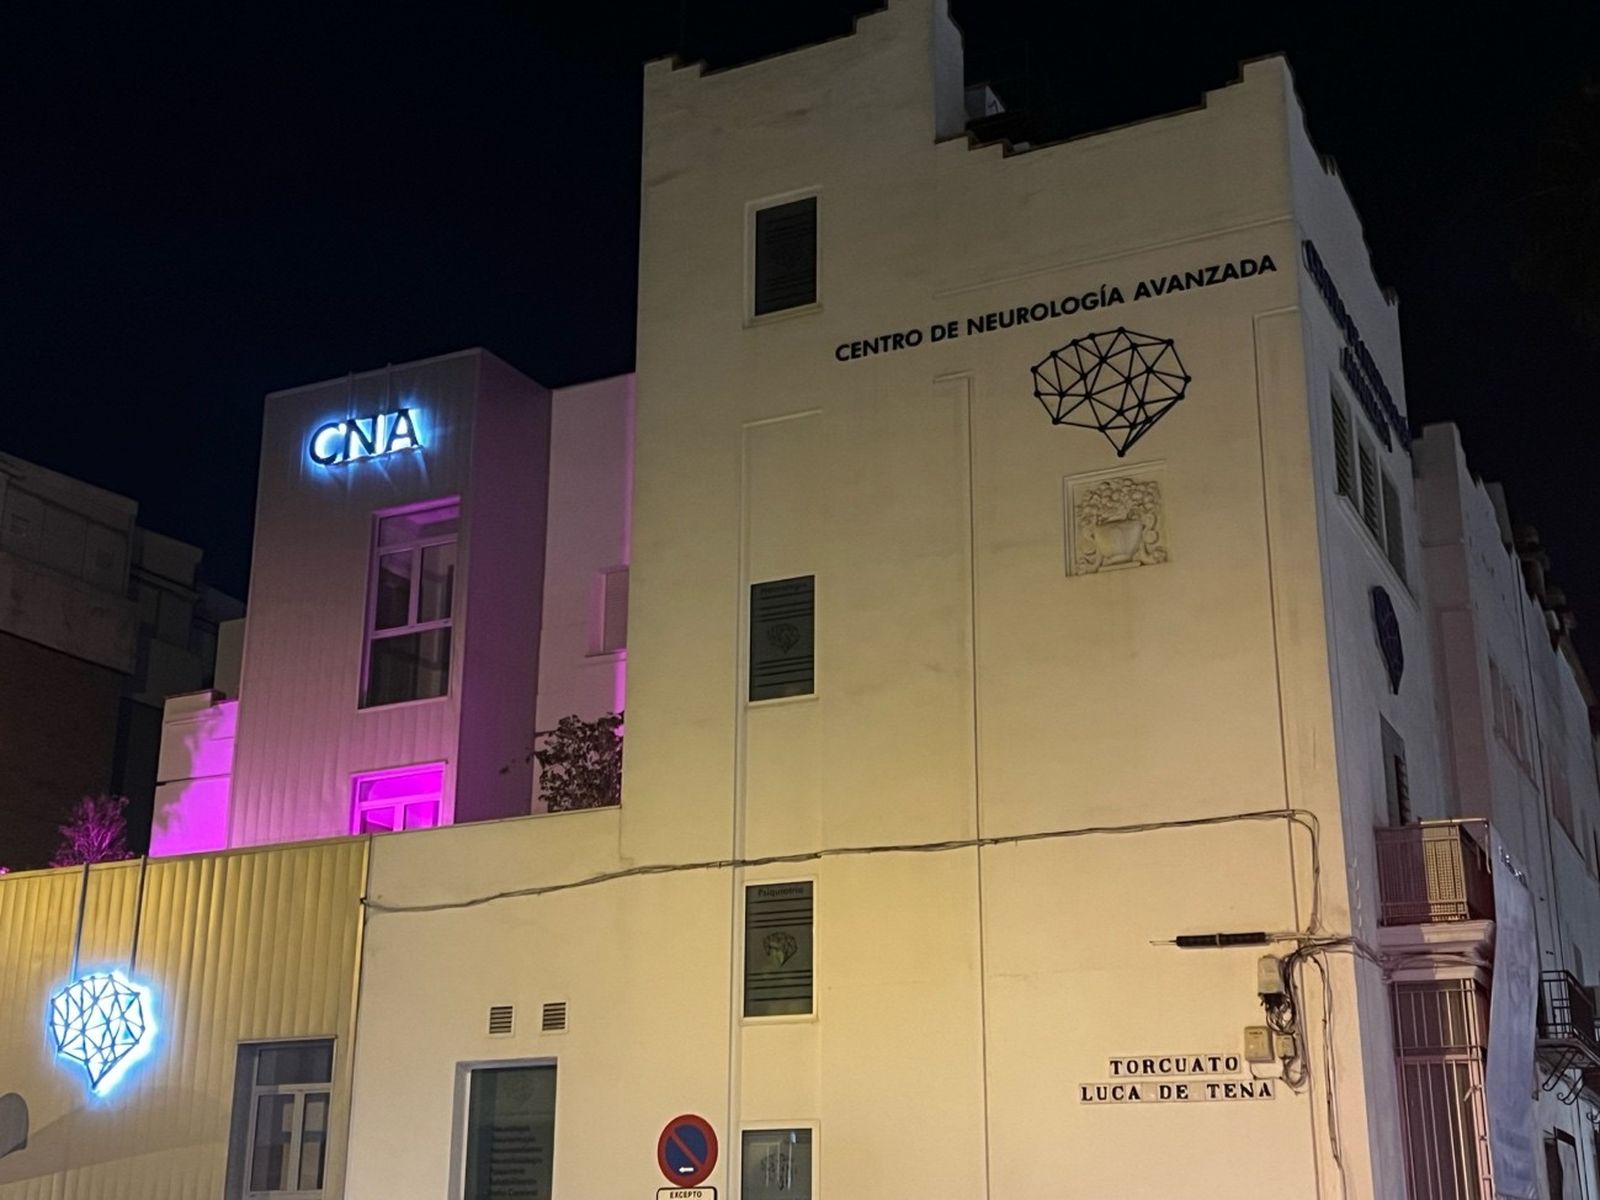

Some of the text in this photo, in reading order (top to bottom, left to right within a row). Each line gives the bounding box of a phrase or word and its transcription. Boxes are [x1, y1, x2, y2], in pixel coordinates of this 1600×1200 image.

[834, 254, 1278, 362] CENTRO DE NEUROLOGÍA AVANZADA
[308, 407, 423, 466] CNA
[1109, 1056, 1240, 1075] TORCUATO
[1081, 1081, 1272, 1102] LUCA DE TENA
[669, 1190, 703, 1199] EXCEPTO
